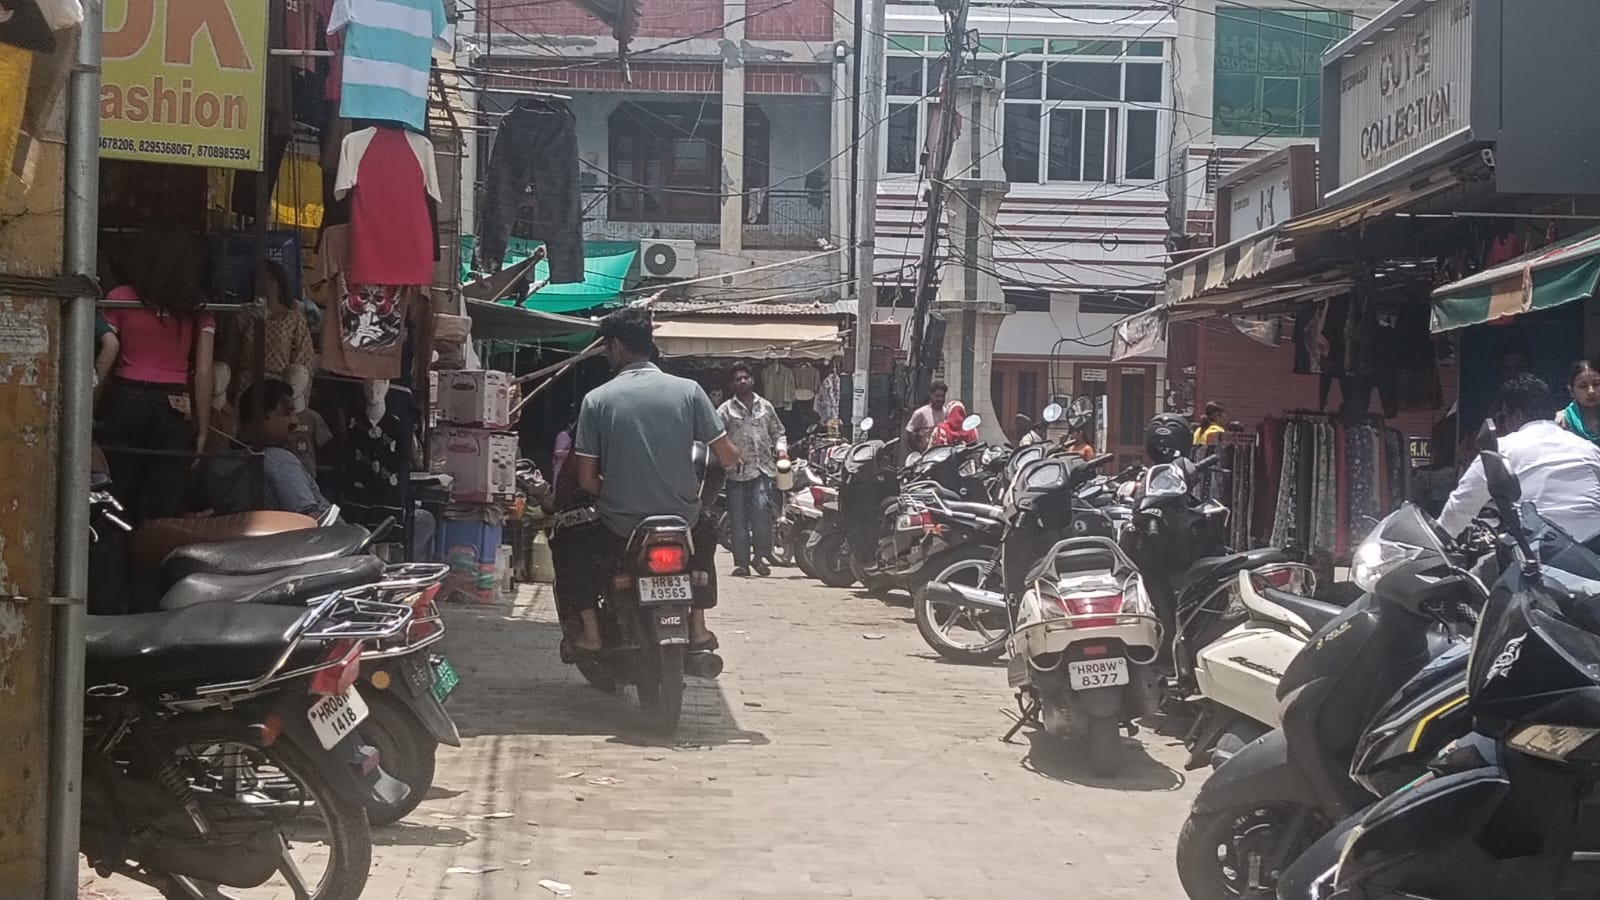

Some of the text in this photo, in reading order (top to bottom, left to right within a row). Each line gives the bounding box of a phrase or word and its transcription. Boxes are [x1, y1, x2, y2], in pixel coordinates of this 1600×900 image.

[1380, 28, 1431, 97] CUTE
[1361, 83, 1451, 161] COLLECTION
[1077, 661, 1117, 675] HR08W
[1082, 672, 1118, 687] 8377
[331, 706, 357, 736] 1418
